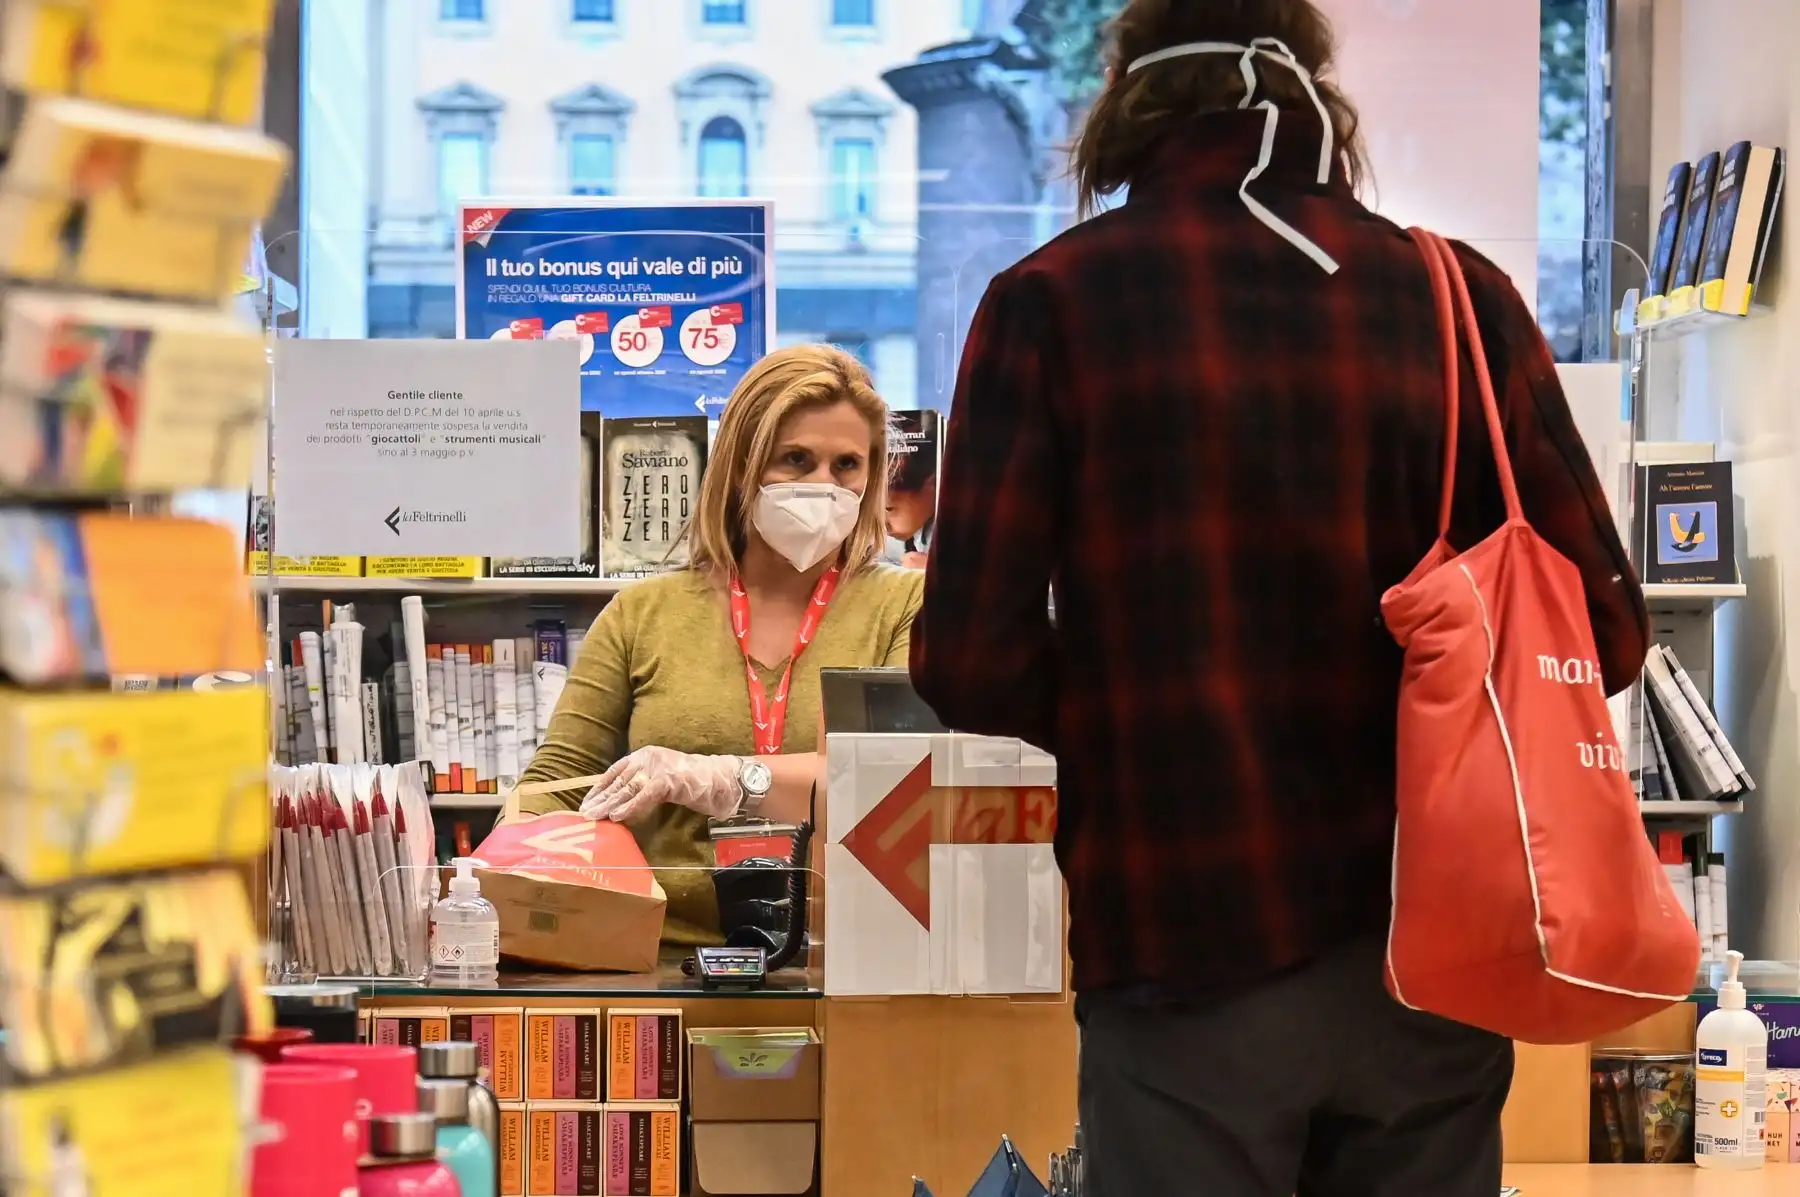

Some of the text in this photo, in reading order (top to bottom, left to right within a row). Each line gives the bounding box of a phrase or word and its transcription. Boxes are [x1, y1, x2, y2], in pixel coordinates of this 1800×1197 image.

[466, 210, 493, 234] NEW
[486, 256, 742, 280] Il tuo bonus qui vale di più
[487, 284, 520, 293] SPENDI
[552, 284, 571, 292] TUO
[572, 284, 607, 292] BONUS
[608, 284, 651, 292] CULTURA
[560, 294, 584, 303] GIFT
[585, 294, 616, 303] CARD
[617, 293, 631, 302] LA
[633, 293, 696, 302] FELTRINELLI
[387, 390, 425, 400] Gentile
[330, 407, 345, 417] nel
[347, 407, 384, 419] rispetto
[386, 407, 401, 417] del
[445, 407, 459, 417] del
[463, 408, 475, 417] 10
[477, 407, 504, 419] aprile
[325, 420, 528, 432] resta temporaneamente sospesa la vendita
[306, 435, 321, 444] dei
[323, 434, 362, 445] prodotti
[430, 436, 437, 444] e
[377, 449, 397, 457] sino
[400, 448, 409, 457] al
[411, 449, 418, 457] 3
[420, 449, 457, 460] maggio
[622, 452, 689, 469] Saviano
[622, 474, 689, 496] ZERO
[402, 510, 467, 523] laFeltrinelli
[622, 497, 689, 519] ZERO
[541, 1020, 549, 1063] WILLIAM
[622, 1022, 630, 1064] WILLIAM
[499, 1049, 508, 1093] WILLIAM
[508, 1118, 516, 1161] WILLIAM
[541, 1118, 550, 1161] WILLIAM
[662, 1117, 671, 1160] WILLIAM
[1714, 1137, 1738, 1146] 500ml
